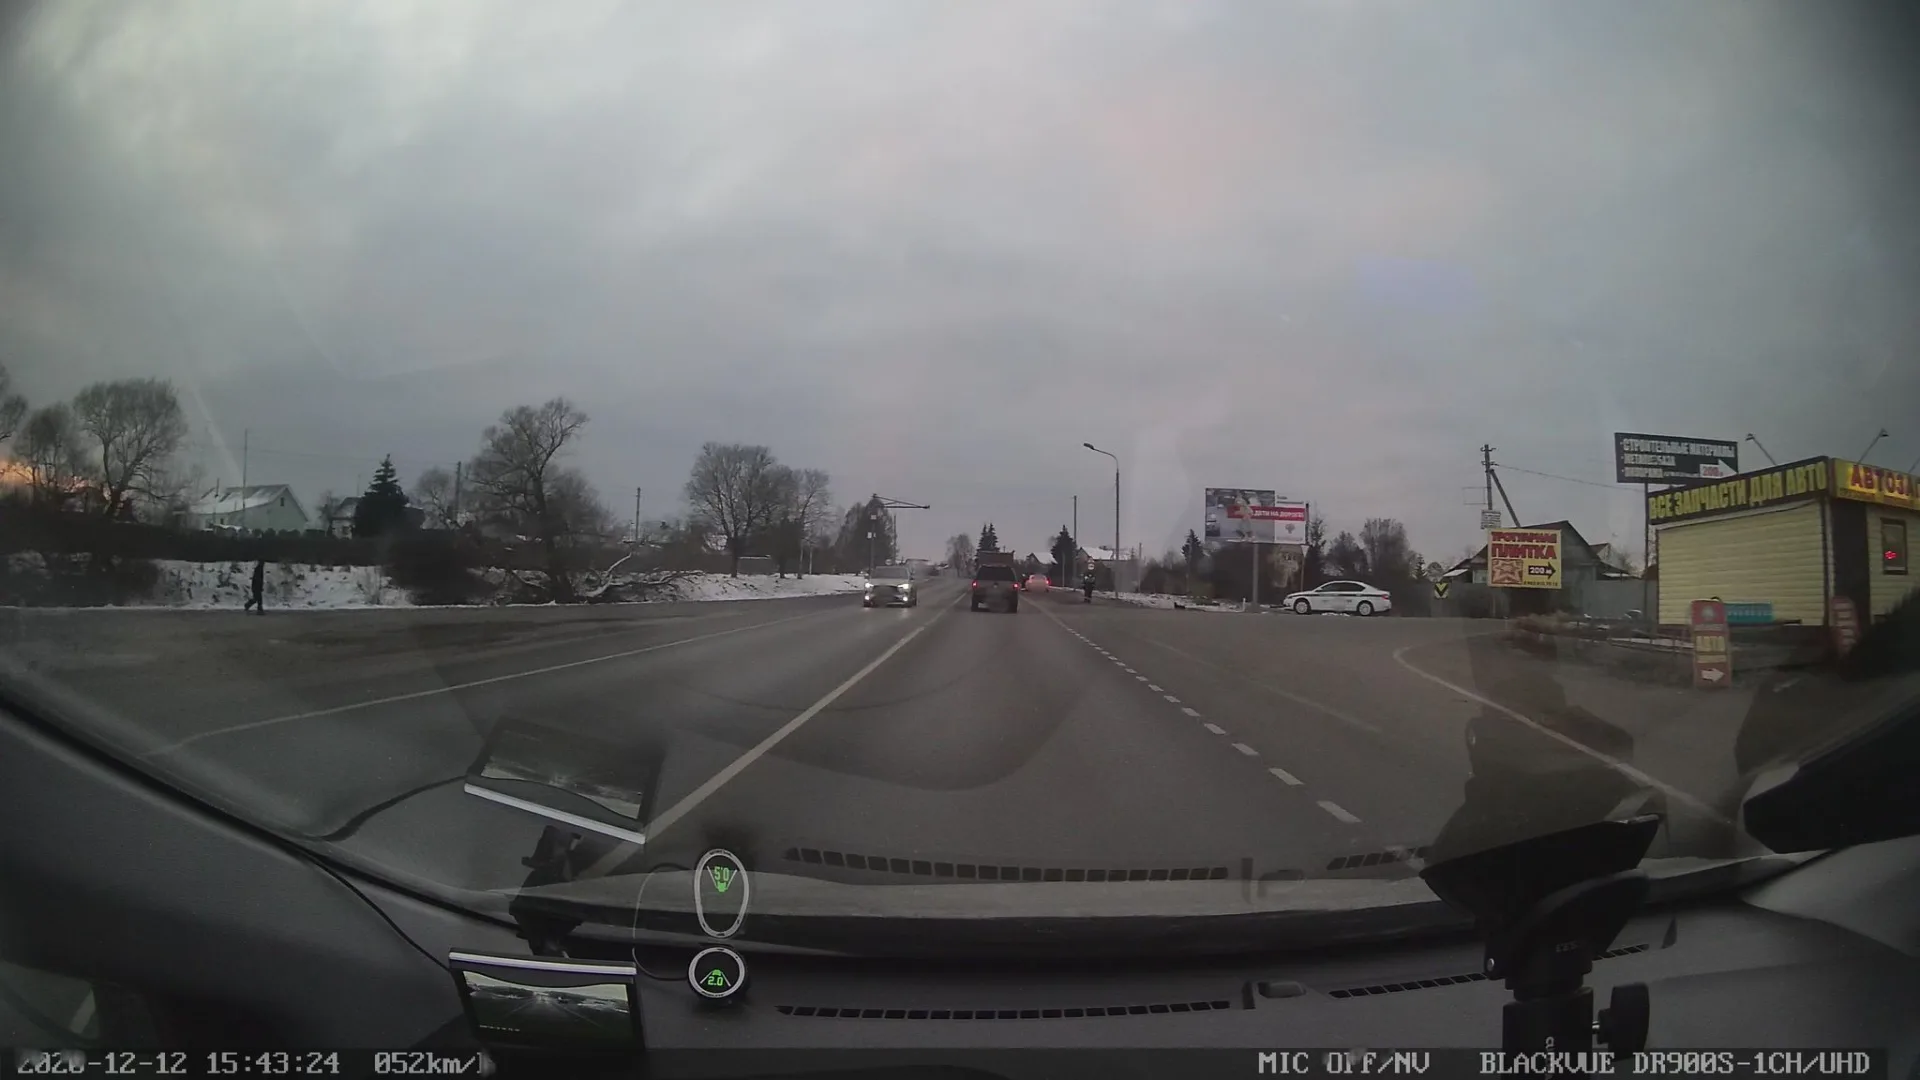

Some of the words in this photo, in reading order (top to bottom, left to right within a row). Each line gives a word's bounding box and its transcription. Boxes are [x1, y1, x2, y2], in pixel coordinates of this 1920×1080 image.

[1649, 493, 1673, 520] ВСЕ
[1673, 479, 1747, 516] ЗАПЧАСТИ
[1749, 472, 1783, 506] ДЛЯ
[1785, 461, 1827, 497] АВТО
[1491, 544, 1557, 560] ПЛИТКА
[1529, 566, 1545, 575] 200
[707, 975, 724, 987] 2.0
